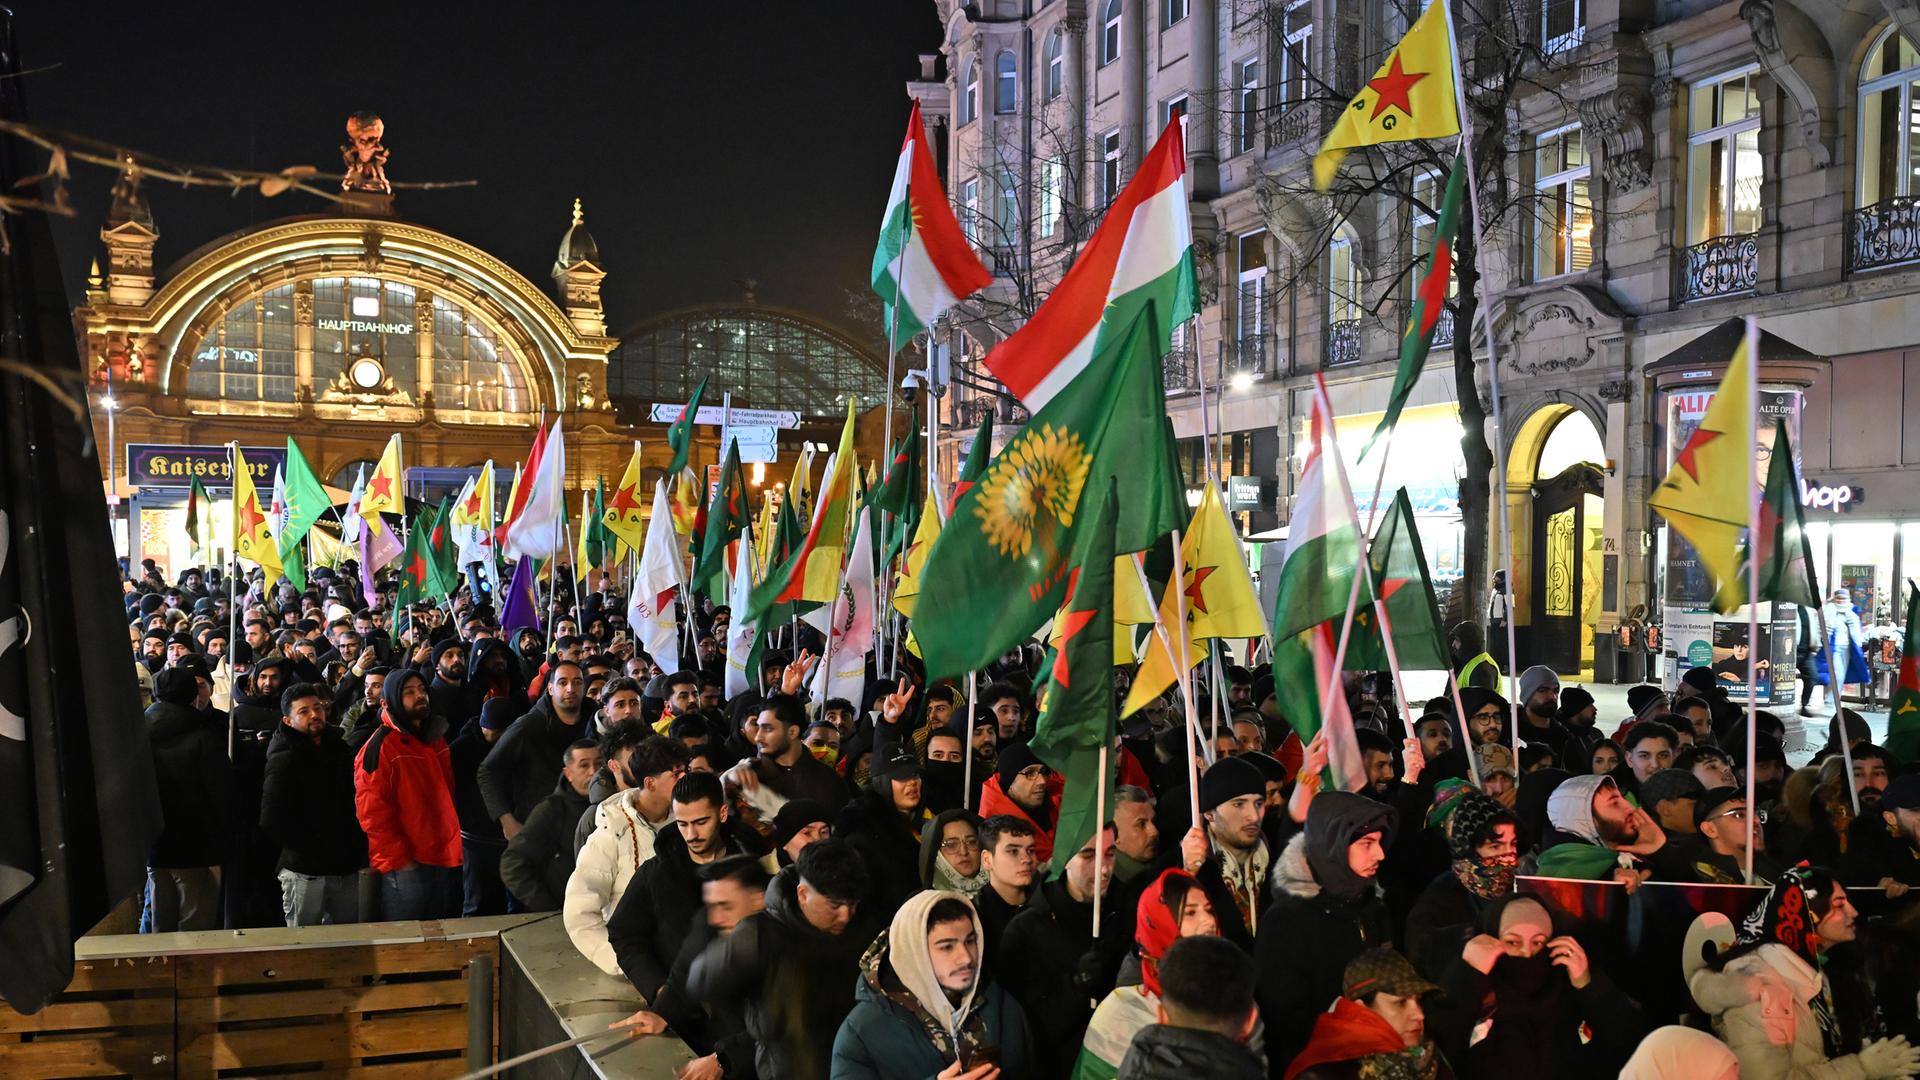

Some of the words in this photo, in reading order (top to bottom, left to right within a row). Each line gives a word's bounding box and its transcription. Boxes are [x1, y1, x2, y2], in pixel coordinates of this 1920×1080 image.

[318, 319, 414, 335] HAUPTBAHNHOF
[1759, 405, 1779, 413] ALTE
[149, 455, 271, 478] Kaiseror
[1234, 483, 1260, 493] fritten
[1236, 492, 1258, 500] werk
[1603, 537, 1616, 553] 74
